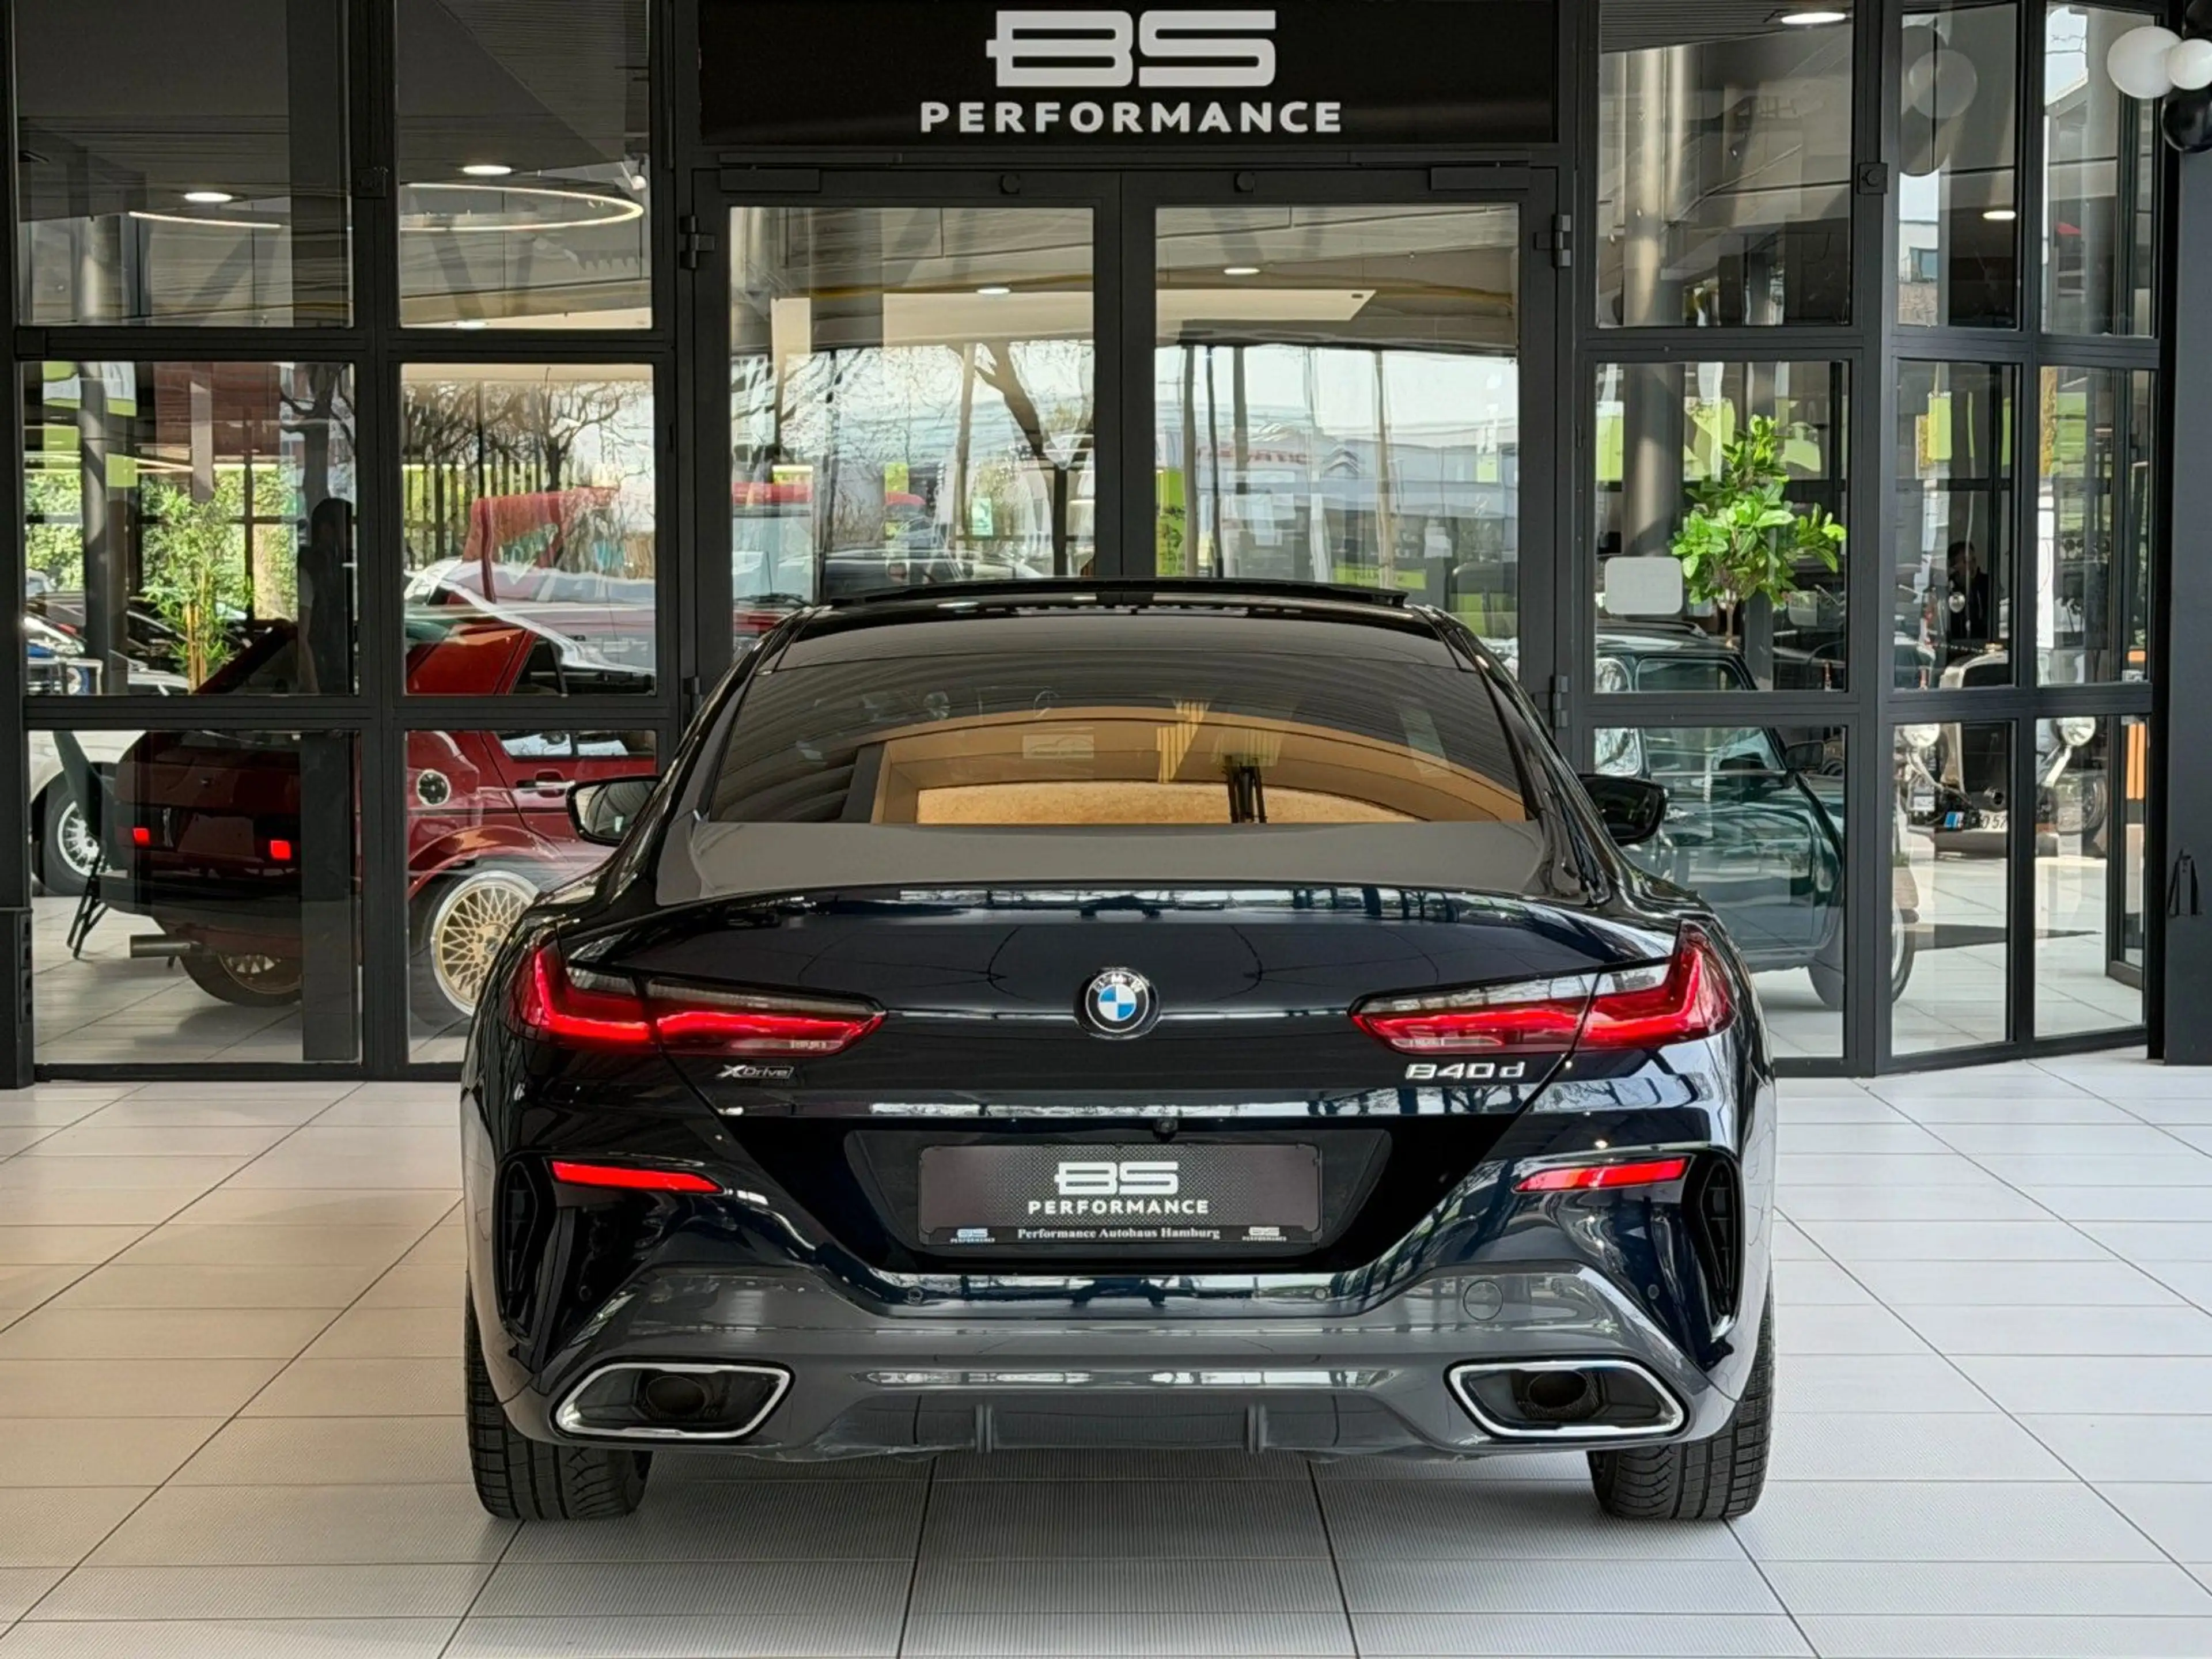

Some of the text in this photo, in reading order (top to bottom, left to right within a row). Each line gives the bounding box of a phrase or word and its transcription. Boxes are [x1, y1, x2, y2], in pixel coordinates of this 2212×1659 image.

[921, 102, 1342, 133] PERFORMANCE
[1405, 1061, 1525, 1080] 840d
[1028, 1200, 1209, 1214] PERFORMANCE
[1018, 1227, 1220, 1240] Performance Autohaus Hamburg
